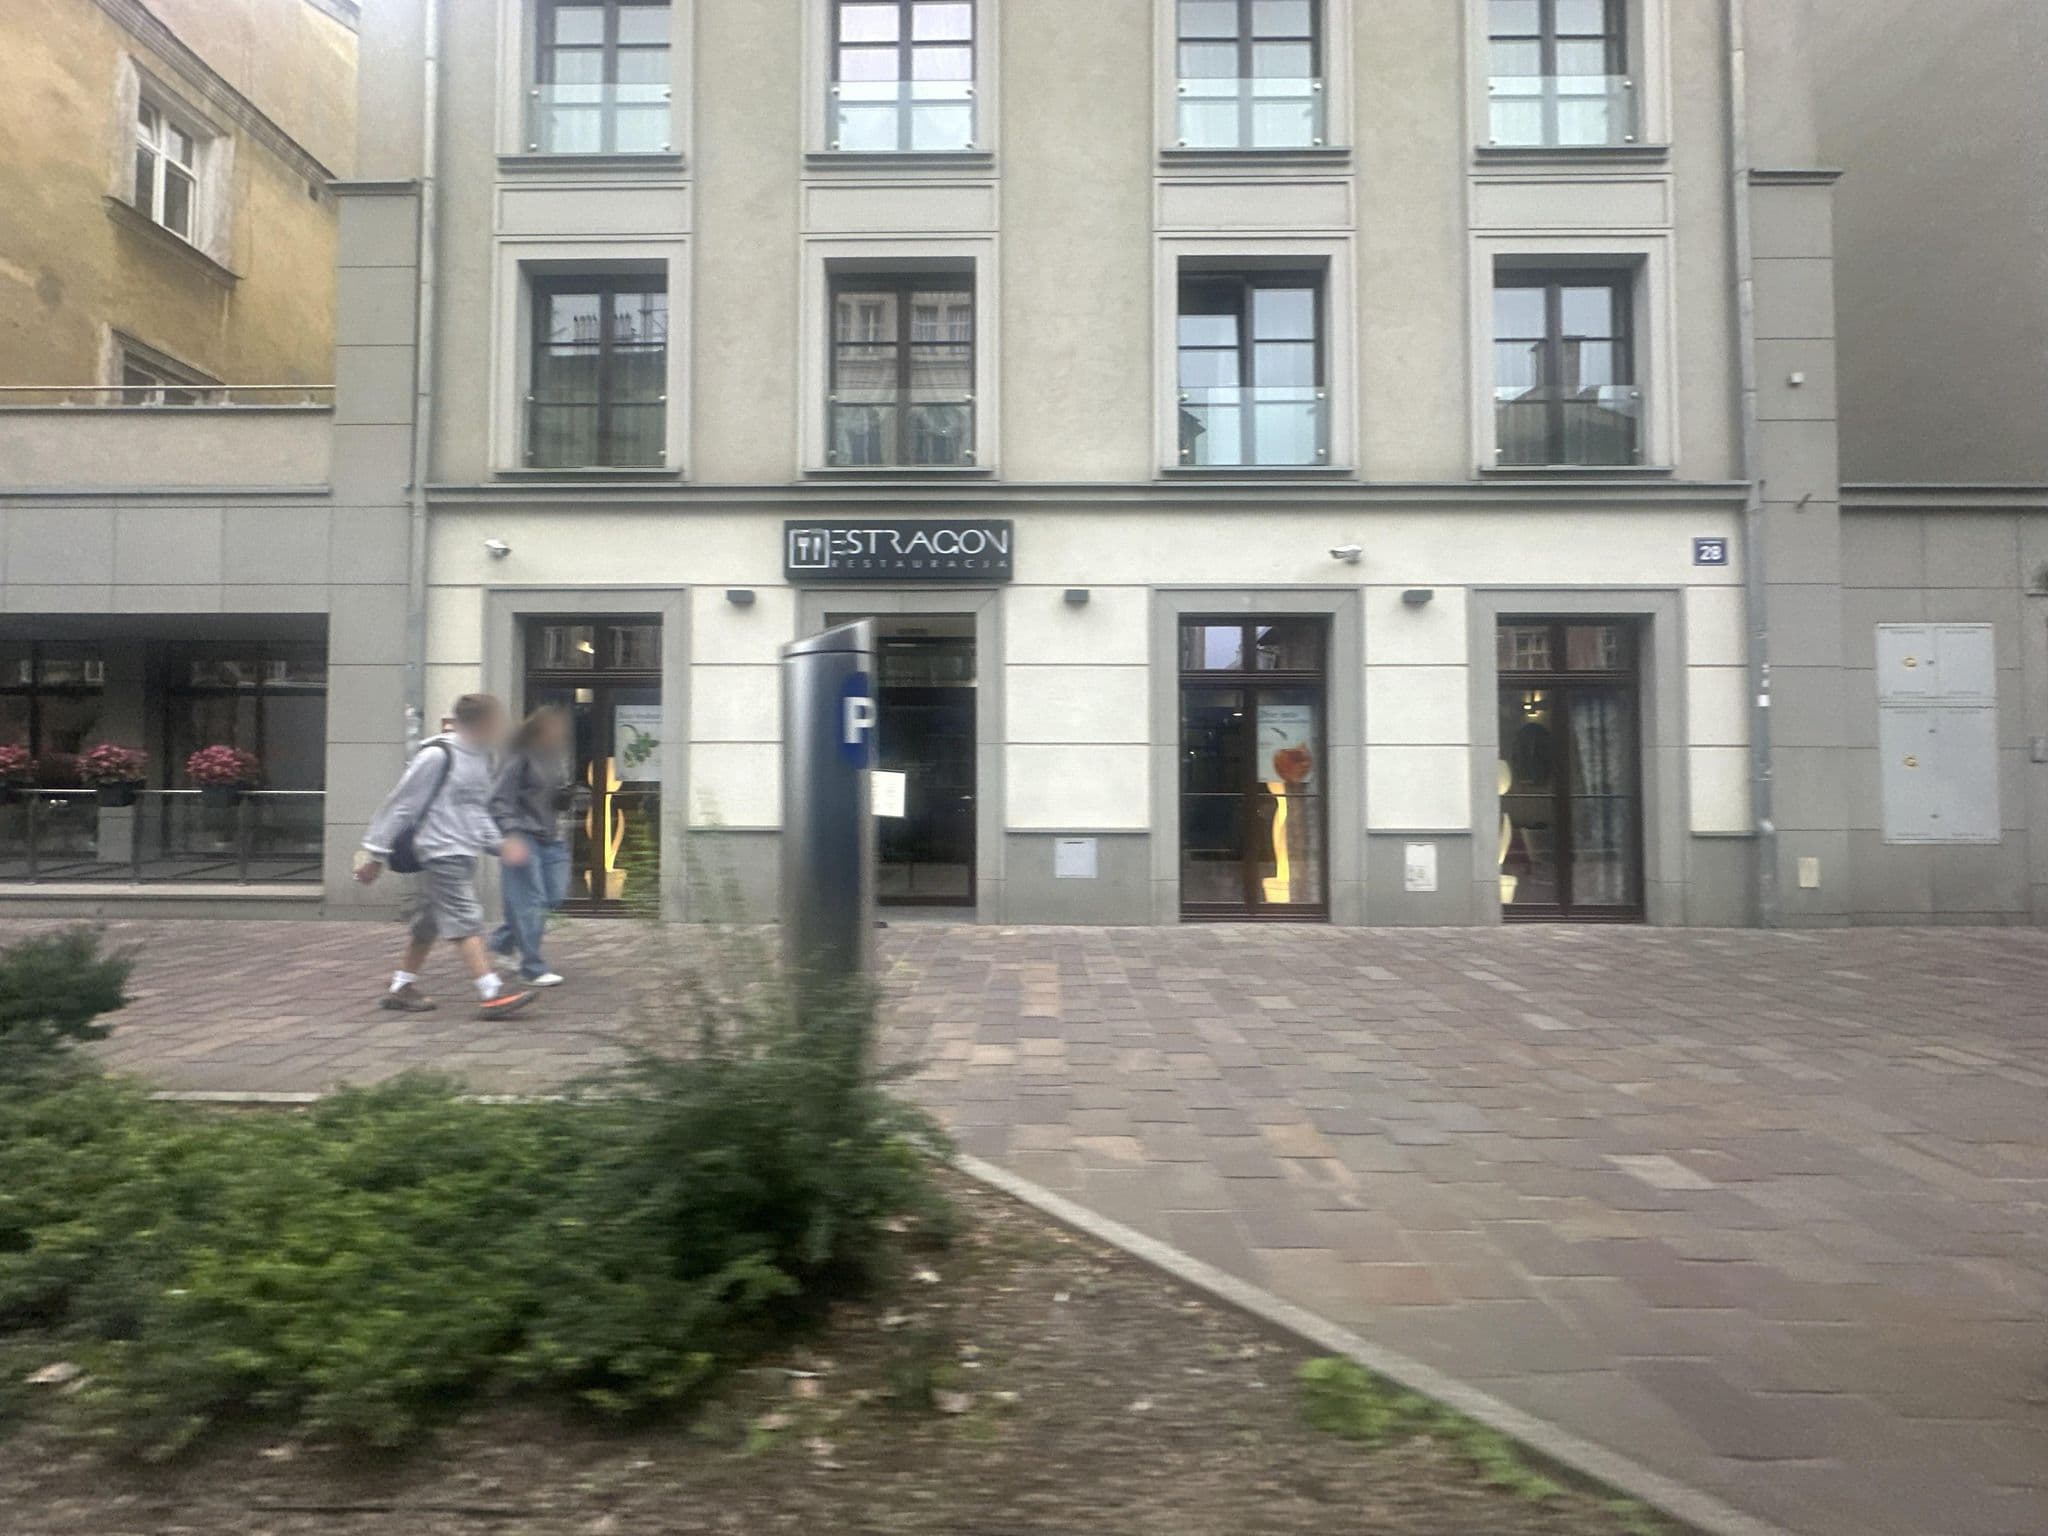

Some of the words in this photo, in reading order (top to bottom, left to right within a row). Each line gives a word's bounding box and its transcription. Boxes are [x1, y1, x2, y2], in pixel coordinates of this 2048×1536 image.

[831, 529, 1008, 554] ESTRAGON
[1699, 545, 1722, 560] 28
[831, 559, 1008, 568] RESTAURACJA
[843, 696, 877, 744] P
